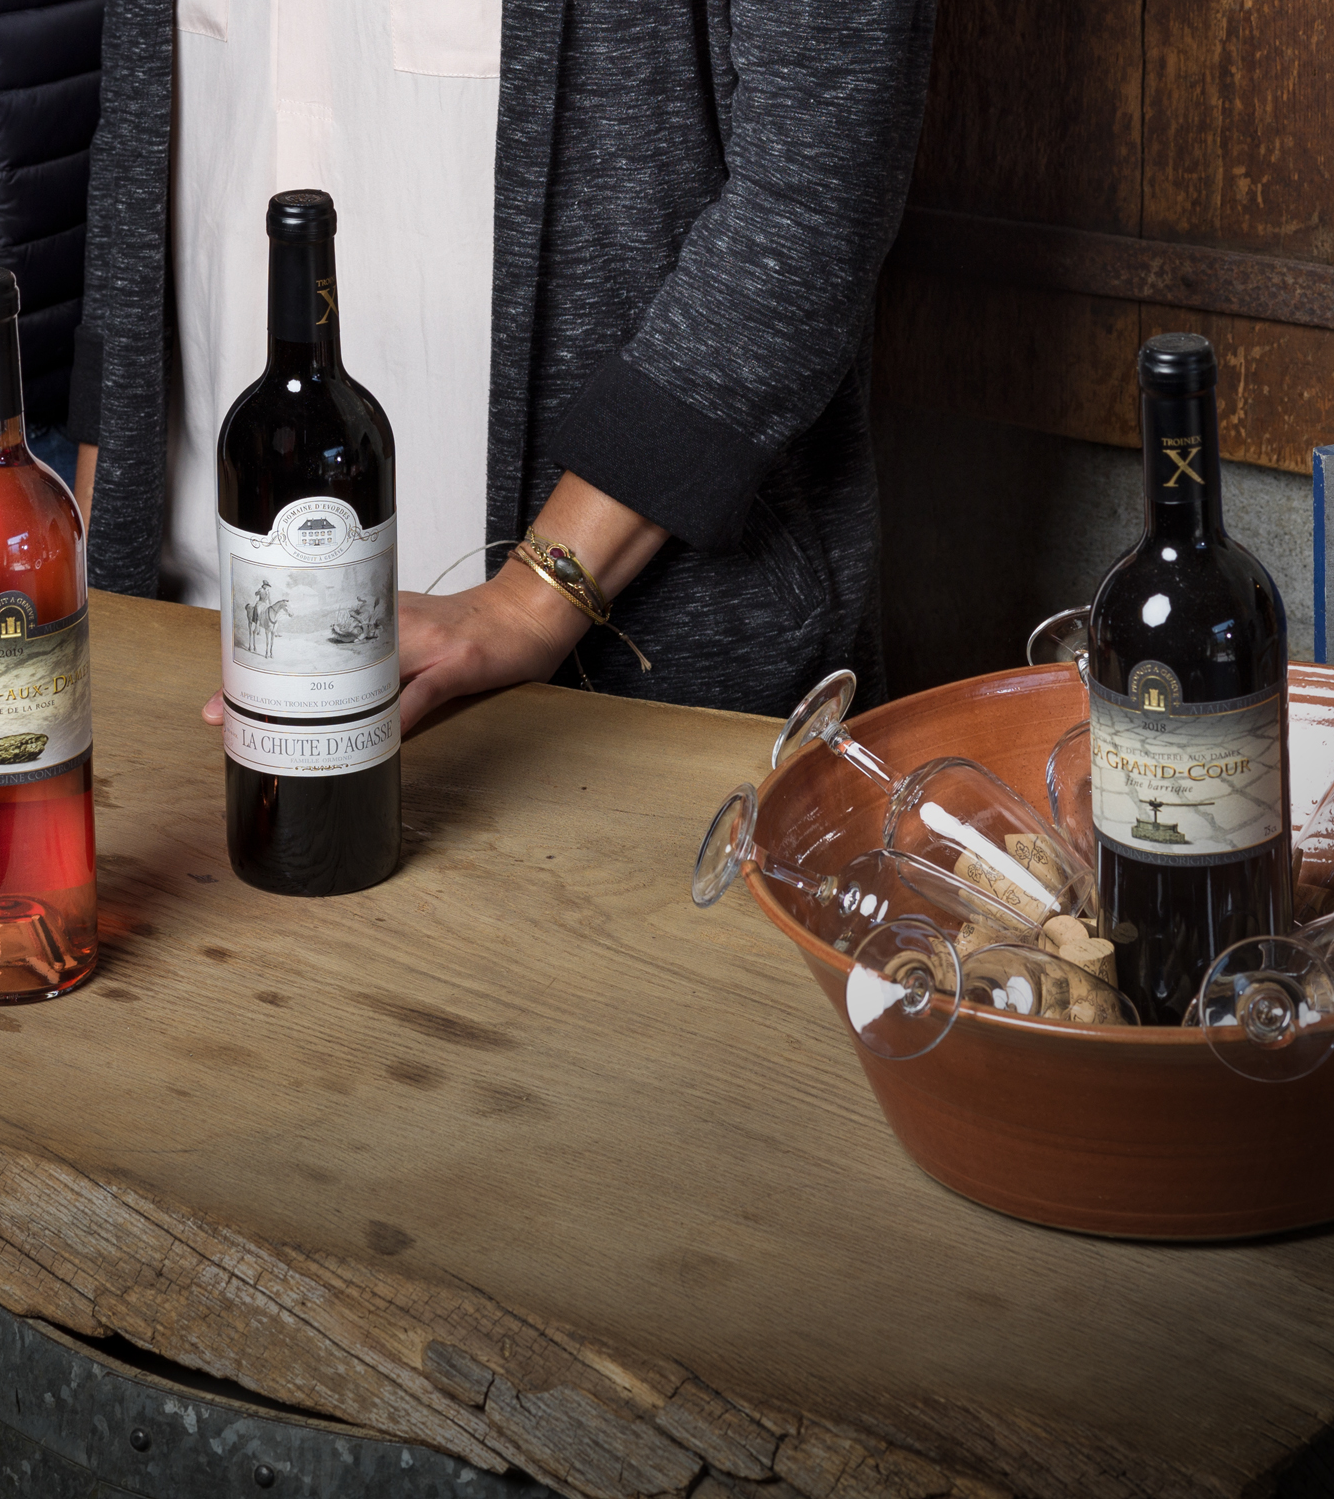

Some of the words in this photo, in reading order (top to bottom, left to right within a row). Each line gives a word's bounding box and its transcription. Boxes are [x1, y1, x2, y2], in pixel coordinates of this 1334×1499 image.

[316, 284, 338, 325] X
[1161, 435, 1202, 446] TROINEX
[1162, 447, 1205, 487] X
[283, 504, 312, 524] DOMAINE
[315, 504, 350, 520] D'EVORDES
[293, 551, 317, 561] PRODUIT
[0, 647, 24, 658] 2019
[310, 681, 334, 691] 2016
[240, 691, 282, 706] APPELLATION
[321, 695, 360, 707] D'ORIGINE
[23, 704, 33, 712] LA
[1190, 702, 1230, 715] ALAIN
[1142, 720, 1167, 732] 2018
[242, 729, 258, 751] LA
[261, 735, 320, 756] CHUTE
[326, 719, 393, 755] D'AGASSE
[322, 754, 353, 763] ORMOND
[1126, 747, 1137, 755] DE
[1152, 751, 1183, 762] PIERRE
[1187, 753, 1207, 762] AUX
[1210, 750, 1241, 761] DAMES
[1105, 750, 1252, 782] GRAND-COUR
[1125, 775, 1143, 788] fine
[1147, 778, 1194, 795] barrique
[1110, 841, 1153, 862] TROINEX
[1157, 854, 1219, 867] D'ORIGINE
